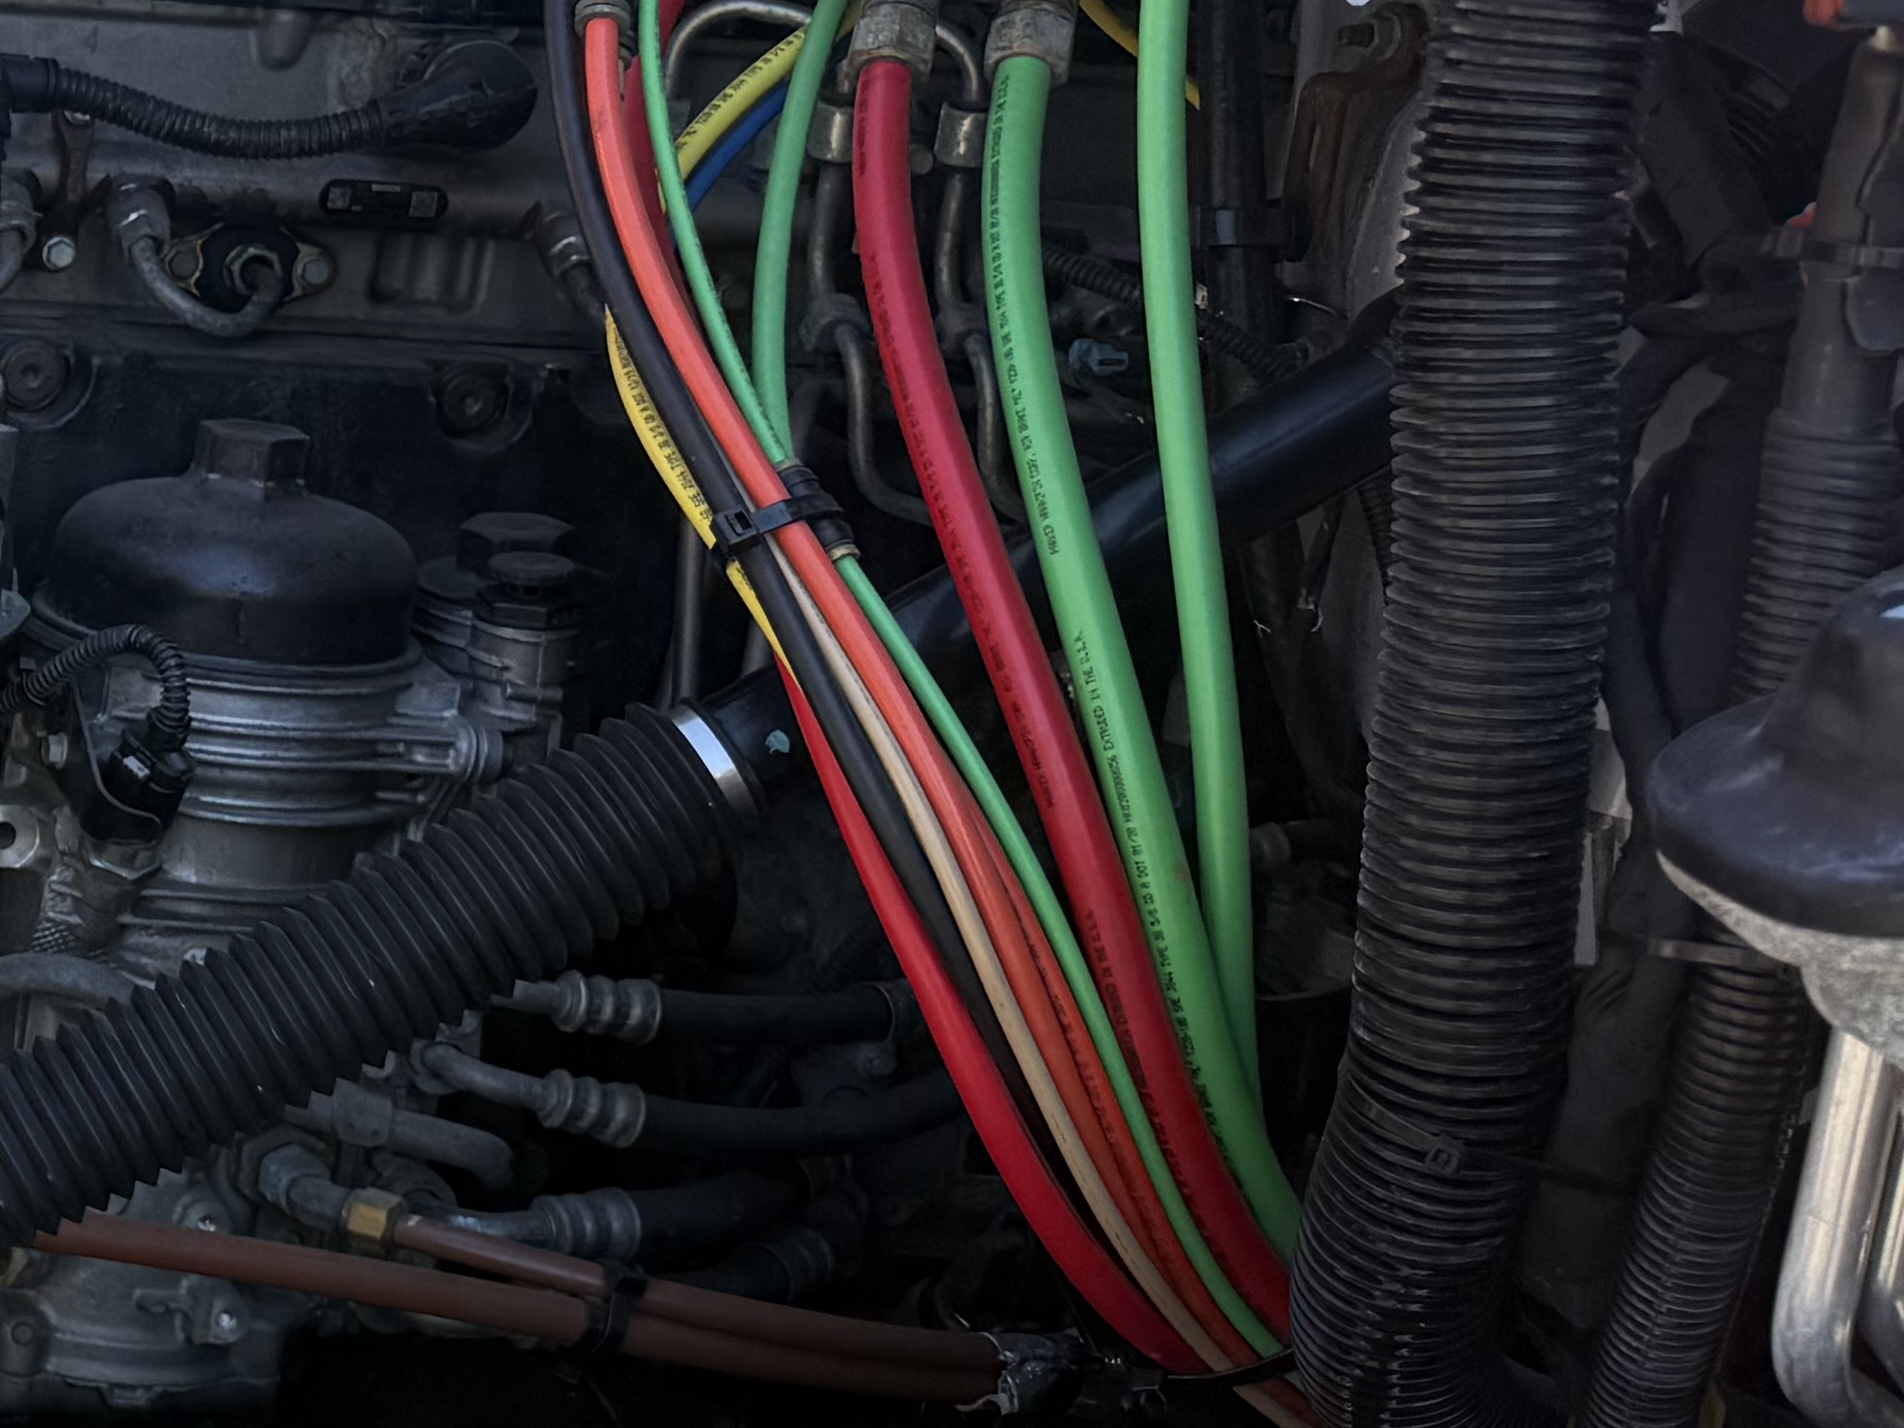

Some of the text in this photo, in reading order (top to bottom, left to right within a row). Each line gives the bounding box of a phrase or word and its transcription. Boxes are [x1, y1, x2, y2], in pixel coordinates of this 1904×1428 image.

[663, 449, 682, 471] TYPE
[1081, 666, 1097, 685] THE
[1092, 704, 1115, 752] EXTRUDED
[1134, 859, 1149, 879] DOT
[1156, 944, 1173, 968] TYPE
